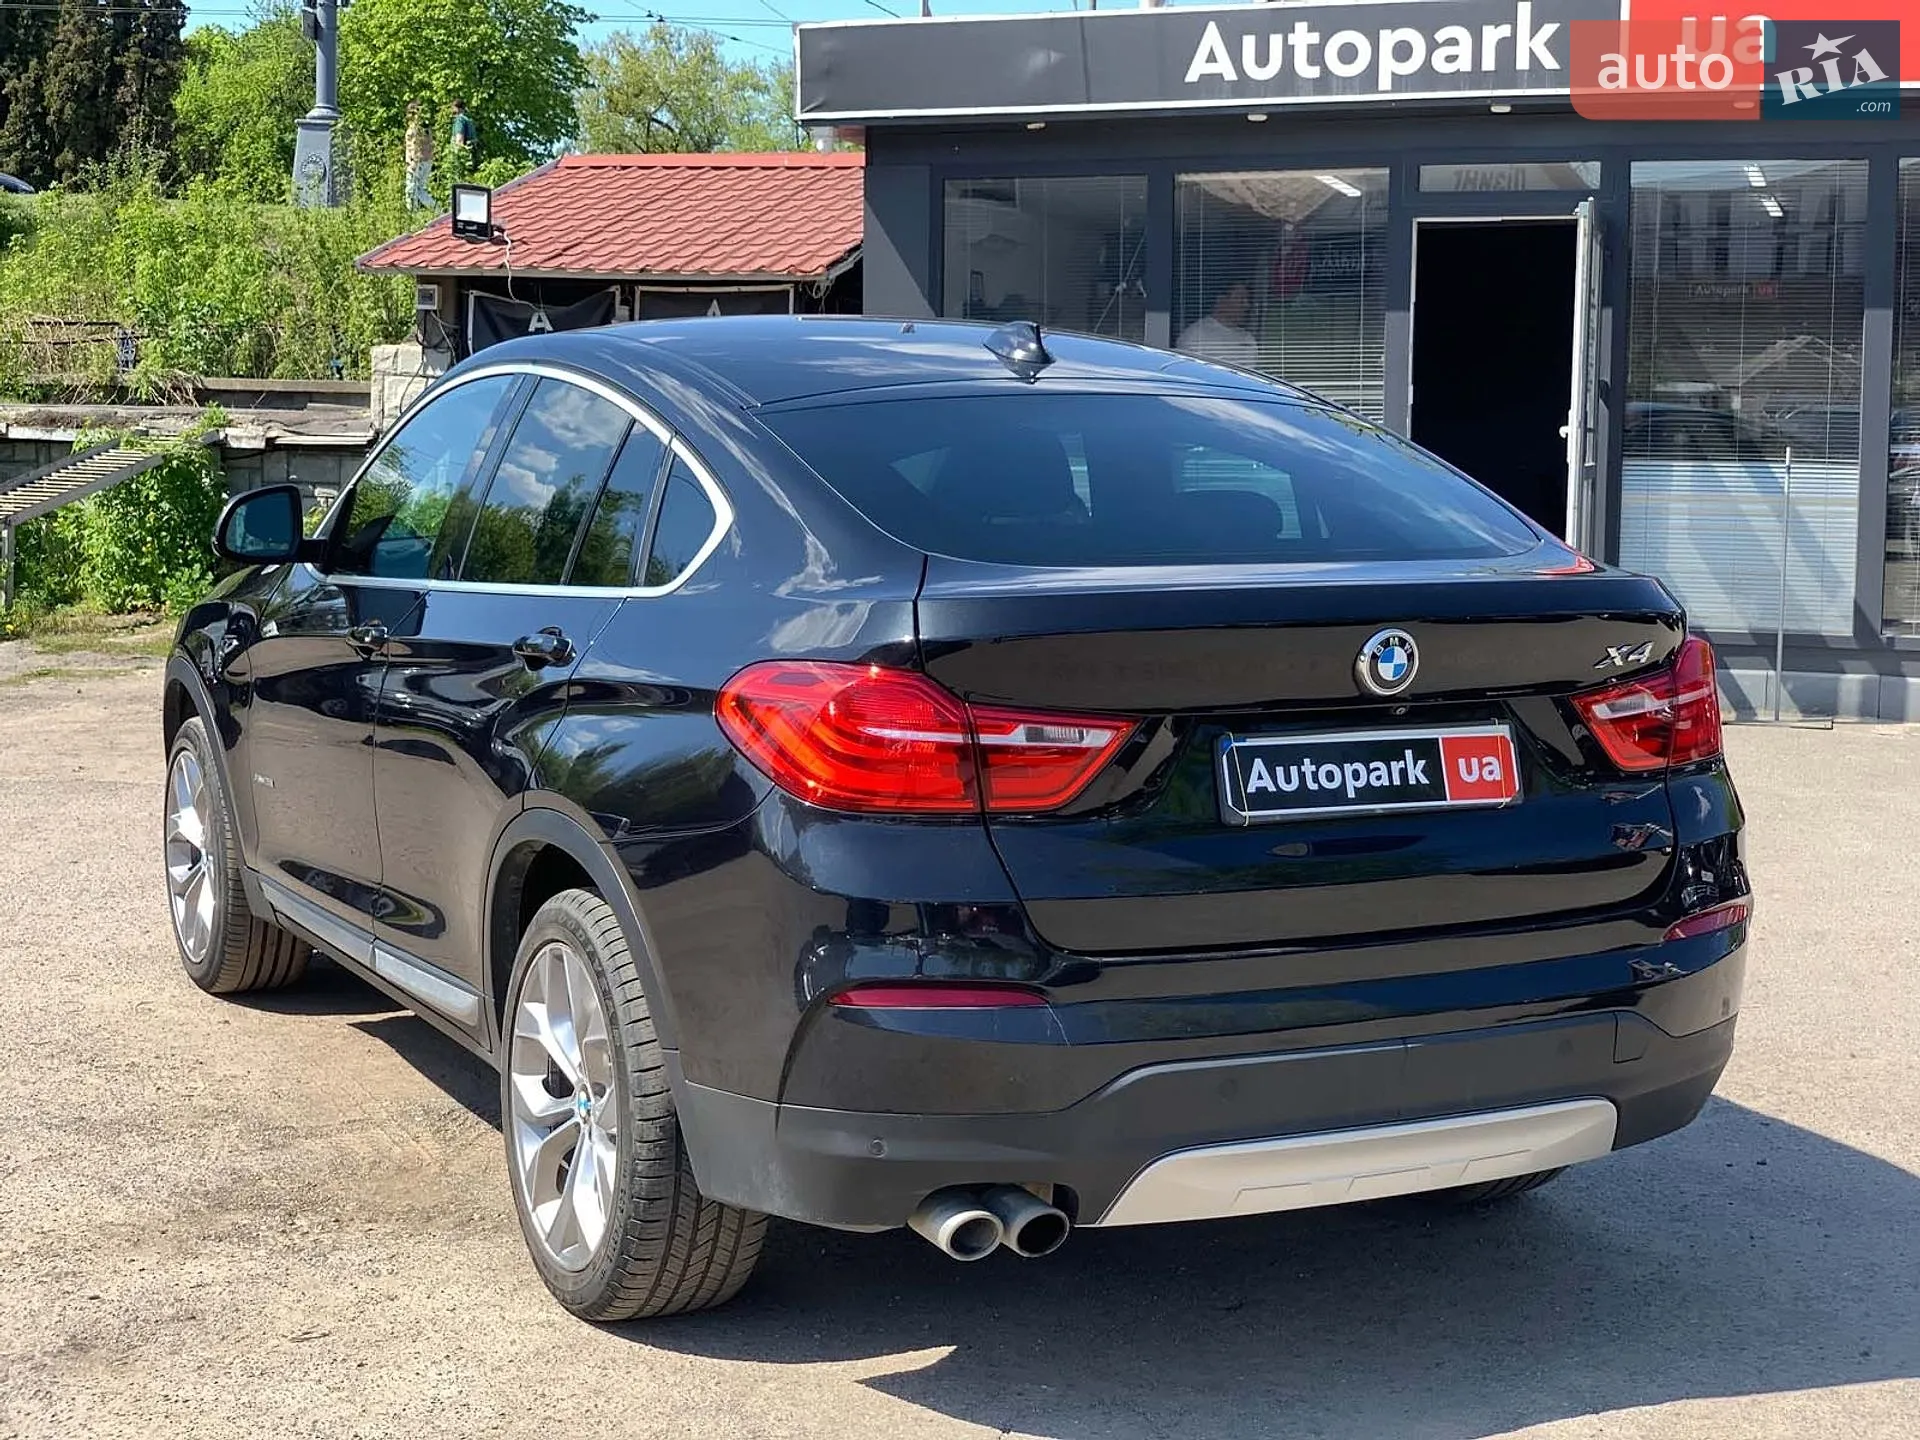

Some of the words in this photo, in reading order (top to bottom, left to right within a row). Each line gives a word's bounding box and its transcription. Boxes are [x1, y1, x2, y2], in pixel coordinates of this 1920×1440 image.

[1184, 1, 1562, 92] Autopark
[1681, 14, 1777, 65] ua
[1374, 637, 1413, 656] BMW
[1594, 641, 1655, 669] X4
[1246, 749, 1430, 798] Autopark
[1457, 755, 1502, 783] ua
